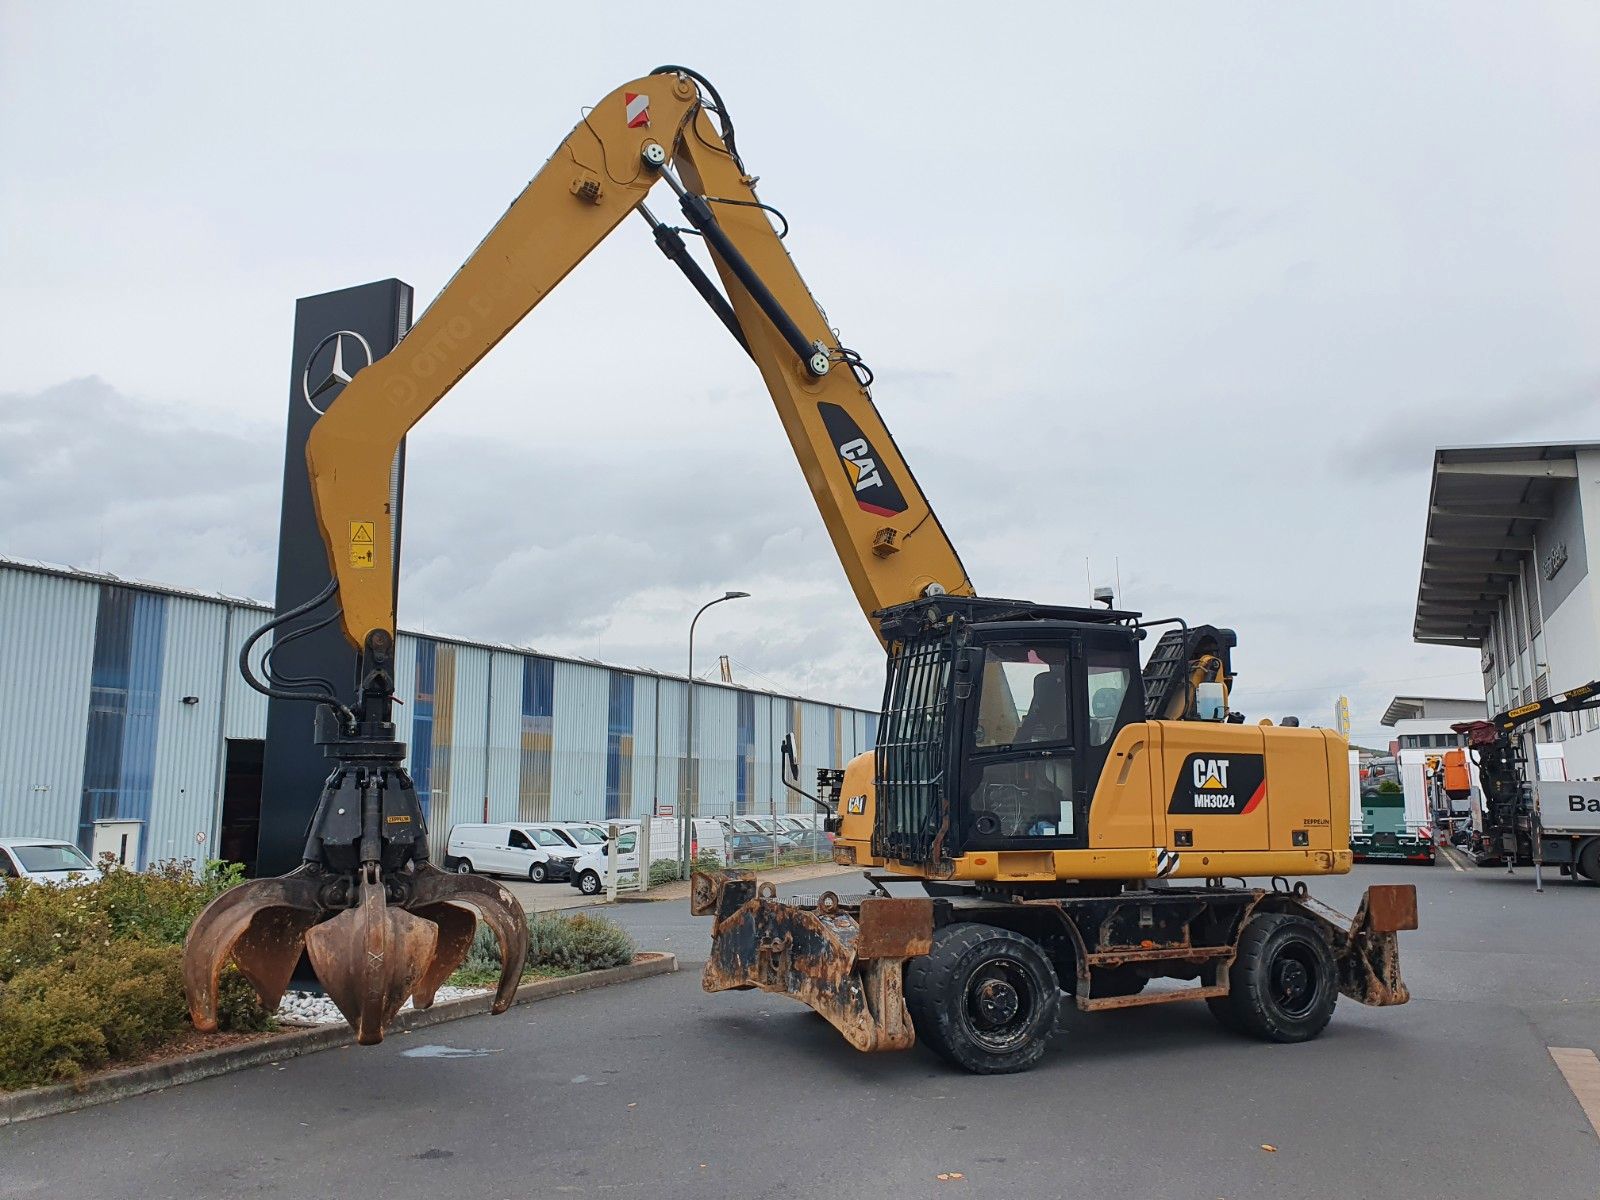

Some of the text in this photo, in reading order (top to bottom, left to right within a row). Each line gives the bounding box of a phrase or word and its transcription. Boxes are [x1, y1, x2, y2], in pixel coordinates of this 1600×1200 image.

[840, 438, 883, 492] CAT
[1193, 758, 1229, 789] CAT
[848, 796, 865, 812] CAT
[1194, 794, 1235, 808] MH3024
[1568, 795, 1600, 812] Ba
